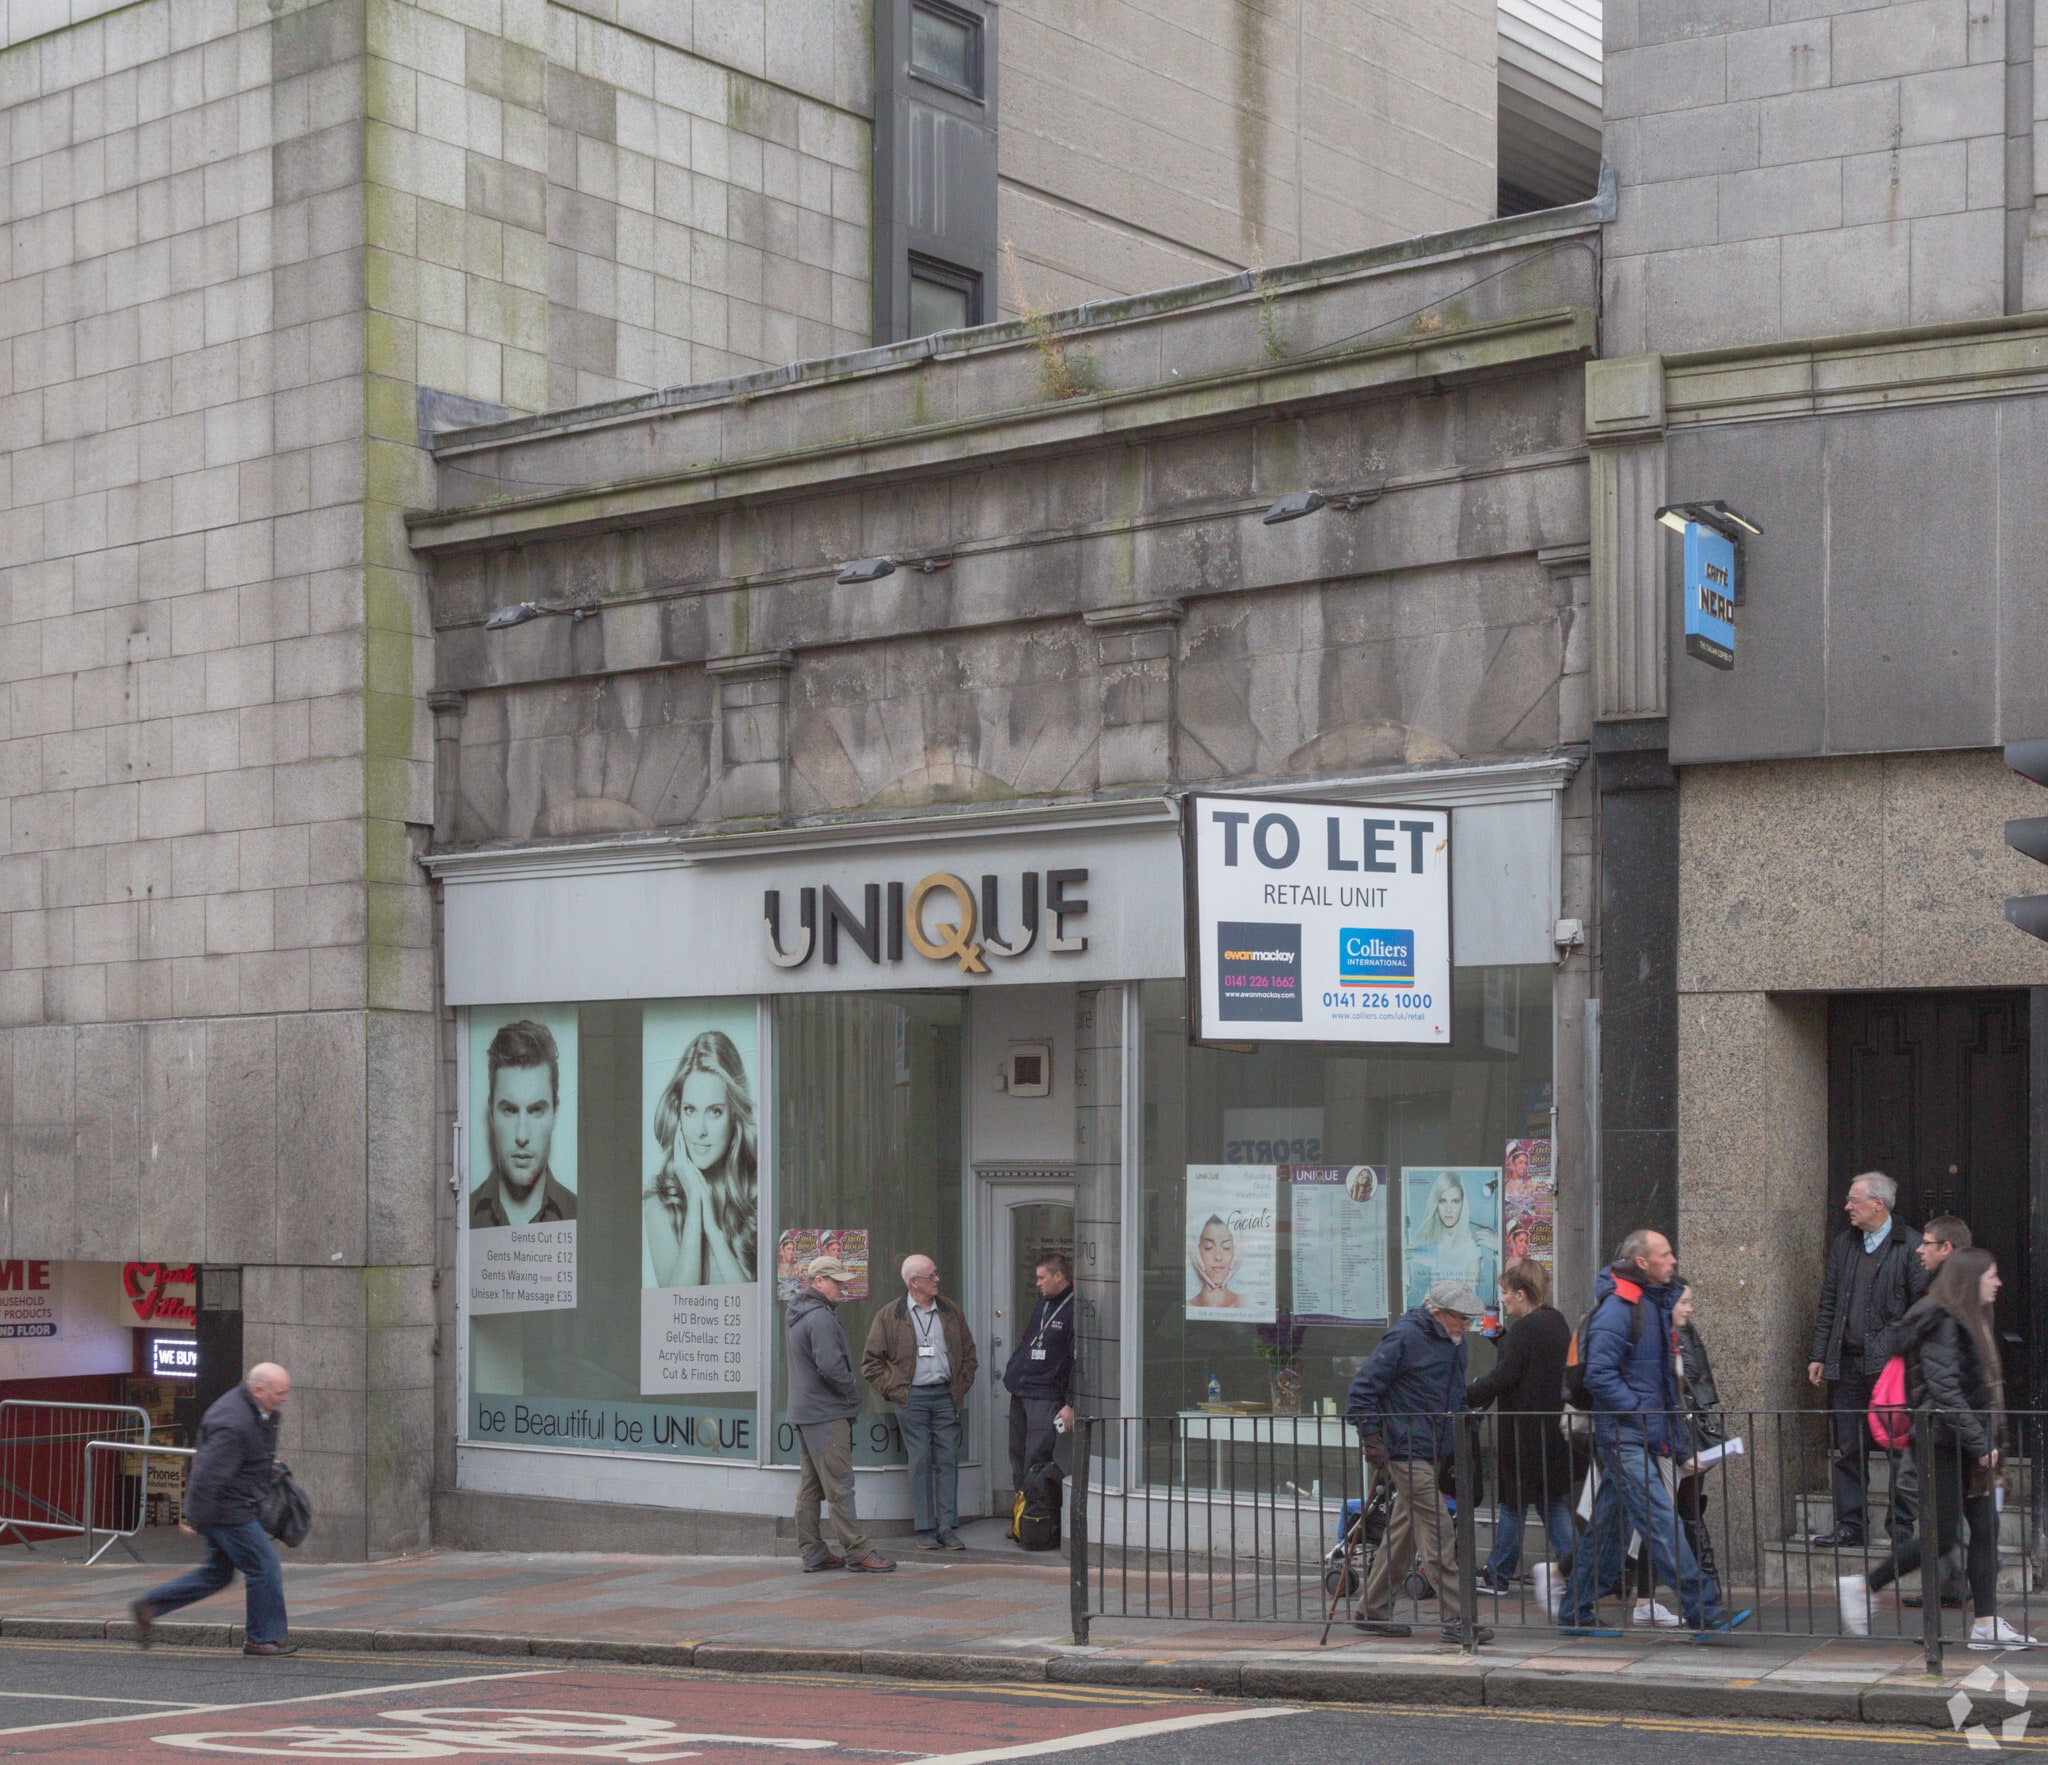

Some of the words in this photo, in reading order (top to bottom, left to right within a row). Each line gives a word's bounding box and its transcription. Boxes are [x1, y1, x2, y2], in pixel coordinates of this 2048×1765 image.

[1699, 583, 1733, 625] NERO
[1212, 811, 1301, 870] TO
[1327, 816, 1434, 874] LET
[1264, 884, 1333, 906] RETAIL
[1339, 887, 1388, 908] UNIT
[764, 867, 1090, 973] UNIQUE
[1346, 937, 1408, 958] Colliers
[1224, 949, 1295, 964] ewanmackay
[1347, 958, 1407, 967] INTERNATIONAL
[1224, 975, 1247, 987] 0141
[1249, 976, 1269, 987] 226
[1271, 976, 1295, 988] 1662
[1224, 991, 1296, 1000] www.ewanmackay.com
[1322, 992, 1356, 1008] 0141
[1362, 993, 1390, 1008] 226
[1395, 993, 1432, 1009] 1000
[1331, 1012, 1425, 1022] www.colliers.com/uk/retail
[1296, 1169, 1338, 1182] UNIQUE
[1227, 1207, 1271, 1233] Facials
[511, 1232, 536, 1243] Gents
[538, 1232, 553, 1243] Cut
[557, 1231, 573, 1244] £15
[487, 1250, 511, 1262] Gents
[513, 1250, 553, 1263] Manicure
[557, 1251, 573, 1263] £12
[481, 1269, 506, 1281] Gents
[508, 1270, 538, 1285] Waxing
[557, 1271, 573, 1283] £15
[471, 1288, 499, 1300] Unisex
[502, 1288, 516, 1301] 1hr
[518, 1290, 555, 1304] Massage
[557, 1291, 573, 1302] £35
[673, 1294, 719, 1308] Threading
[724, 1296, 741, 1308] £10
[4, 1308, 52, 1320] PRODUCTS
[673, 1313, 687, 1325] HD
[690, 1314, 719, 1326] Brows
[724, 1315, 741, 1326] £25
[16, 1324, 51, 1336] FLOOR
[666, 1331, 719, 1345] Gel/Shellac
[724, 1333, 741, 1345] £22
[158, 1350, 175, 1365] WE
[658, 1349, 695, 1363] Acrylics
[697, 1350, 719, 1363] from
[724, 1351, 741, 1364] £30
[662, 1368, 679, 1381] Cut
[681, 1369, 688, 1381] &
[691, 1368, 719, 1382] Finish
[724, 1370, 741, 1383] £30
[479, 1402, 506, 1433] be
[514, 1405, 604, 1441] Beautiful
[614, 1412, 643, 1443] be
[653, 1415, 750, 1453] UNIQUE
[147, 1466, 180, 1481] Phones
